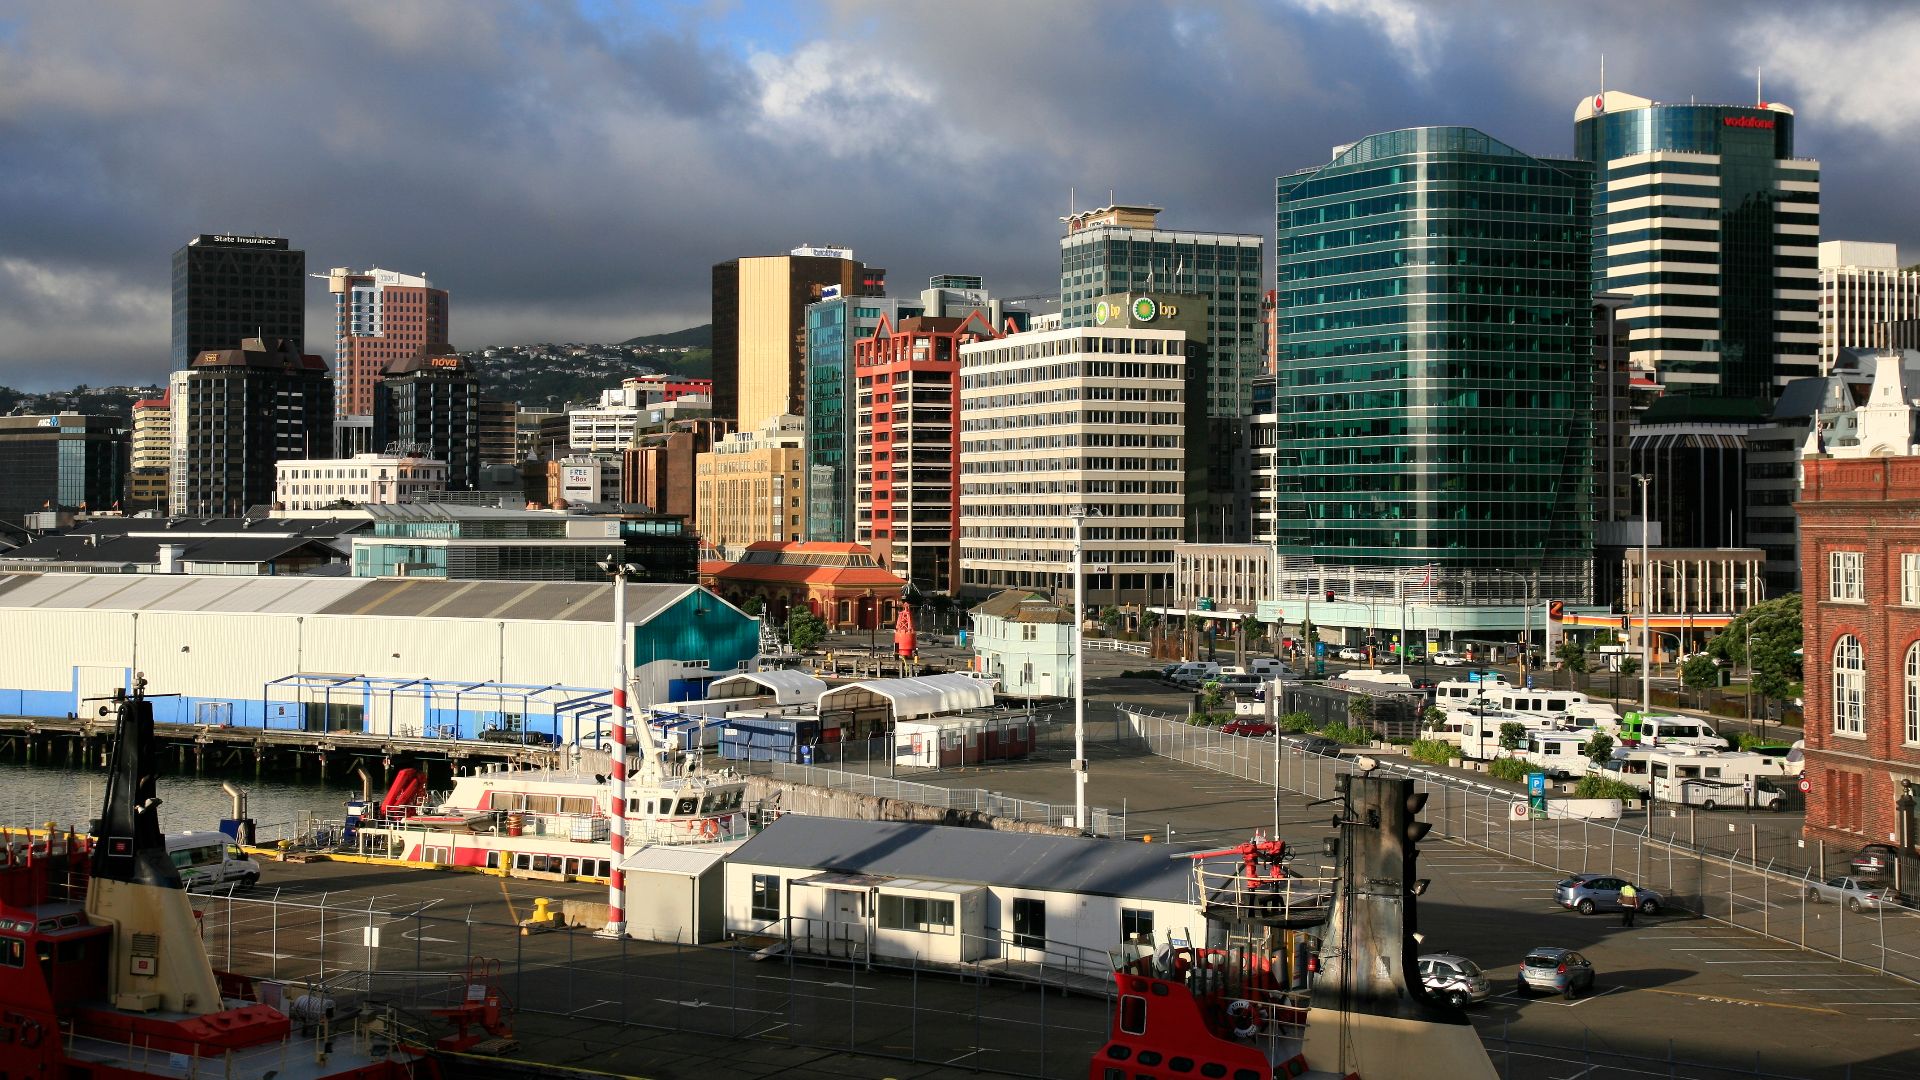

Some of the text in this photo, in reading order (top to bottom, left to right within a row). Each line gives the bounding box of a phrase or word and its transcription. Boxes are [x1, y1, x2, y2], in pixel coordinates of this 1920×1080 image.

[1724, 116, 1775, 129] vodafone
[213, 235, 276, 245] State Insurance
[1110, 304, 1120, 320] bp
[1160, 302, 1176, 318] bp
[431, 358, 457, 367] nova
[734, 432, 754, 442] TOWER
